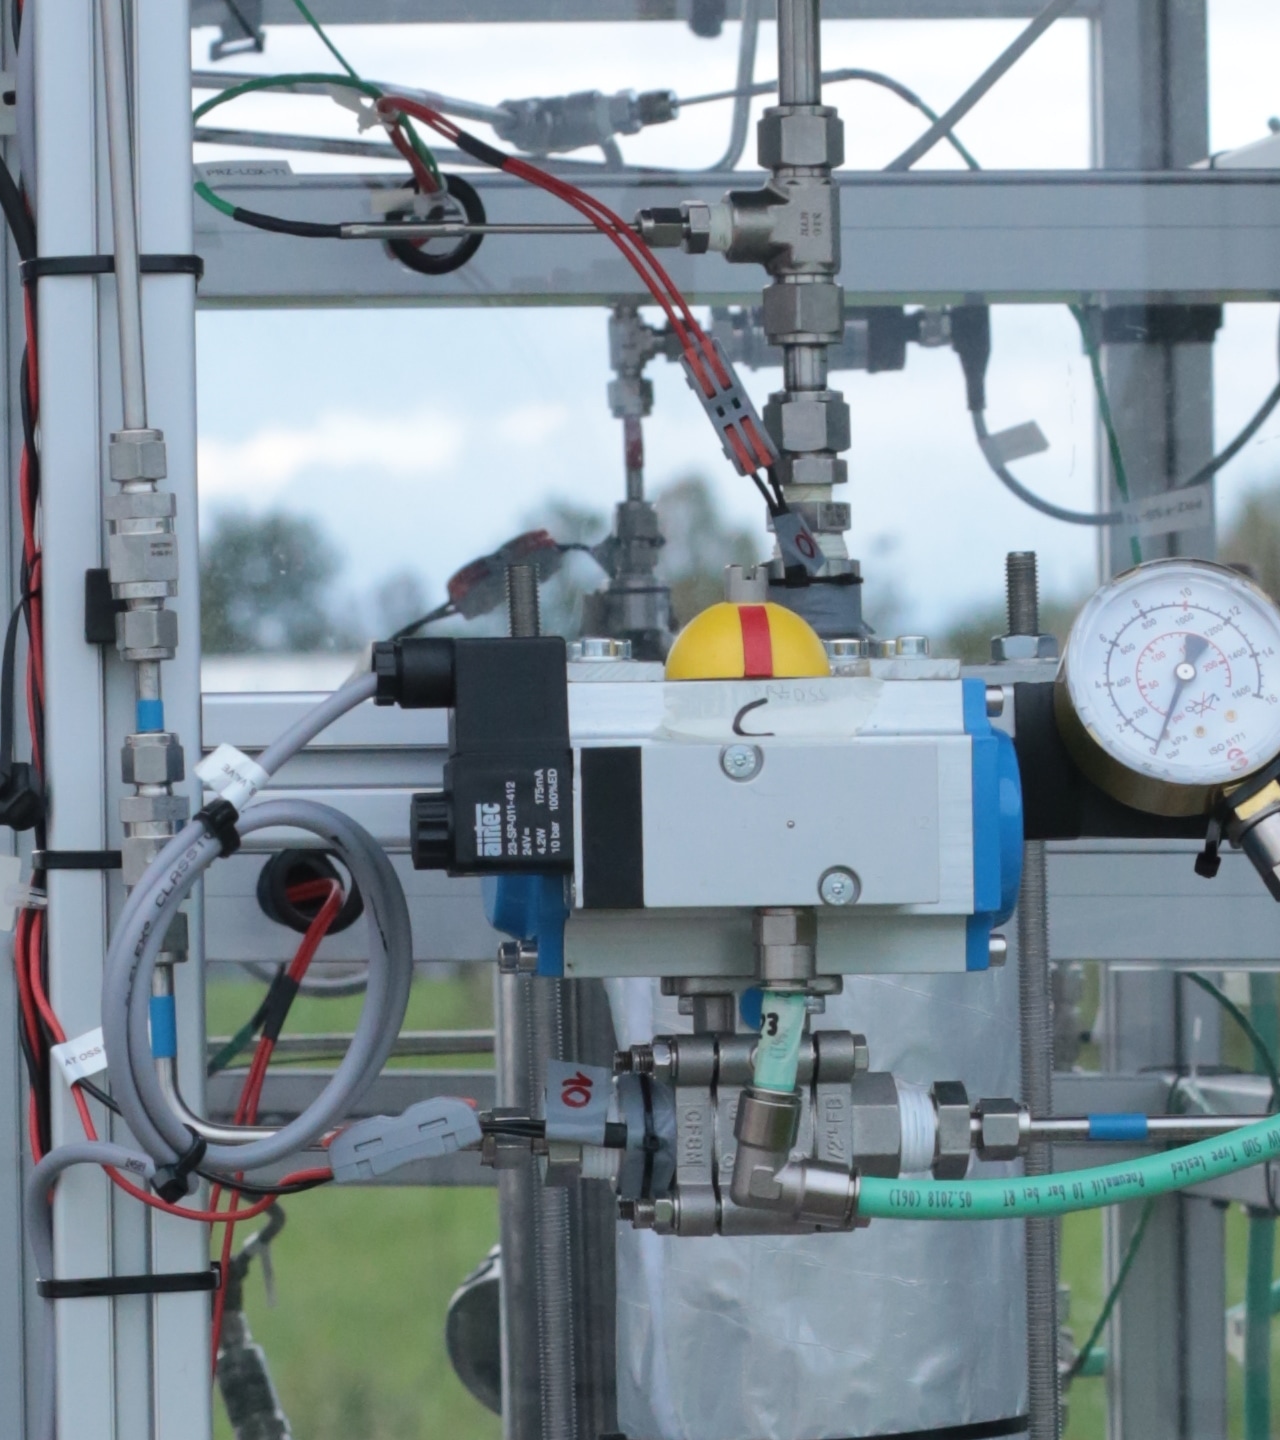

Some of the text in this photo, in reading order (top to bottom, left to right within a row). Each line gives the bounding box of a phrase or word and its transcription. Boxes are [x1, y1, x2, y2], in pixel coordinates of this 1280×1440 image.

[1179, 587, 1192, 599] 10
[1132, 599, 1141, 608] 8
[1229, 605, 1241, 617] 12
[1141, 617, 1157, 629] 800
[1174, 612, 1194, 627] 1000
[1203, 624, 1224, 638] 1200
[1100, 633, 1107, 643] 6
[1151, 651, 1166, 662] 100
[1262, 647, 1275, 657] 14
[1265, 694, 1278, 706] 16
[1133, 706, 1149, 718] 200
[1116, 723, 1125, 734] 2
[1171, 734, 1188, 746] kPa
[1208, 732, 1246, 756] ISO 5171
[1165, 748, 1180, 760] bar
[534, 769, 546, 854] 4.2W 175mA
[505, 781, 517, 855] 23-SP-011-412
[550, 821, 560, 838] bar
[551, 841, 560, 853] 10
[1210, 1144, 1238, 1164] Type
[1171, 1154, 1208, 1181] tested
[1001, 1169, 1146, 1208] Pneumatik 10 bar bei RT
[888, 1187, 973, 1209] 05.2018 (061)
